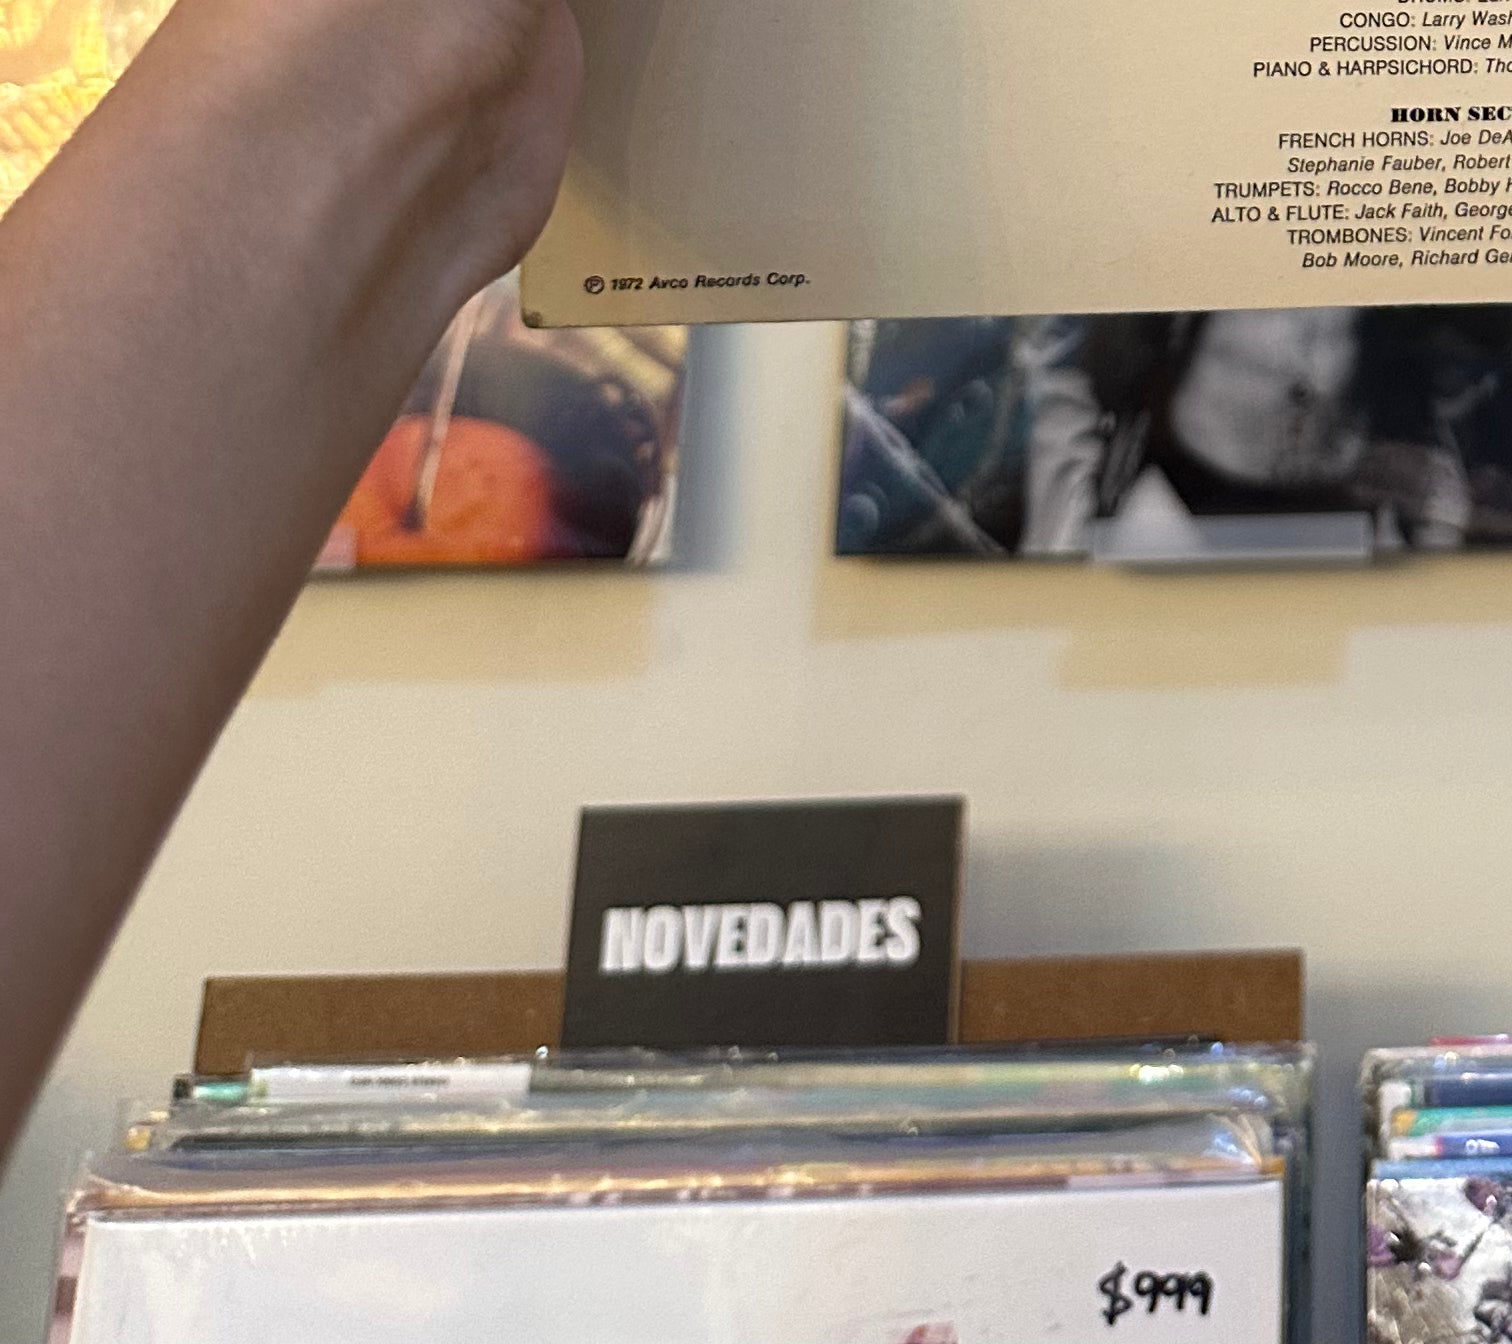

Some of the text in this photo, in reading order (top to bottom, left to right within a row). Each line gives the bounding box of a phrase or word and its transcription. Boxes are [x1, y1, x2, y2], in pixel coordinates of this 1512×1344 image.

[1310, 35, 1436, 52] PERCUSSION:
[1444, 34, 1491, 51] Vince
[1390, 106, 1462, 123] HORN
[601, 897, 921, 972] NOVEDADES
[1100, 1261, 1213, 1325] $999
